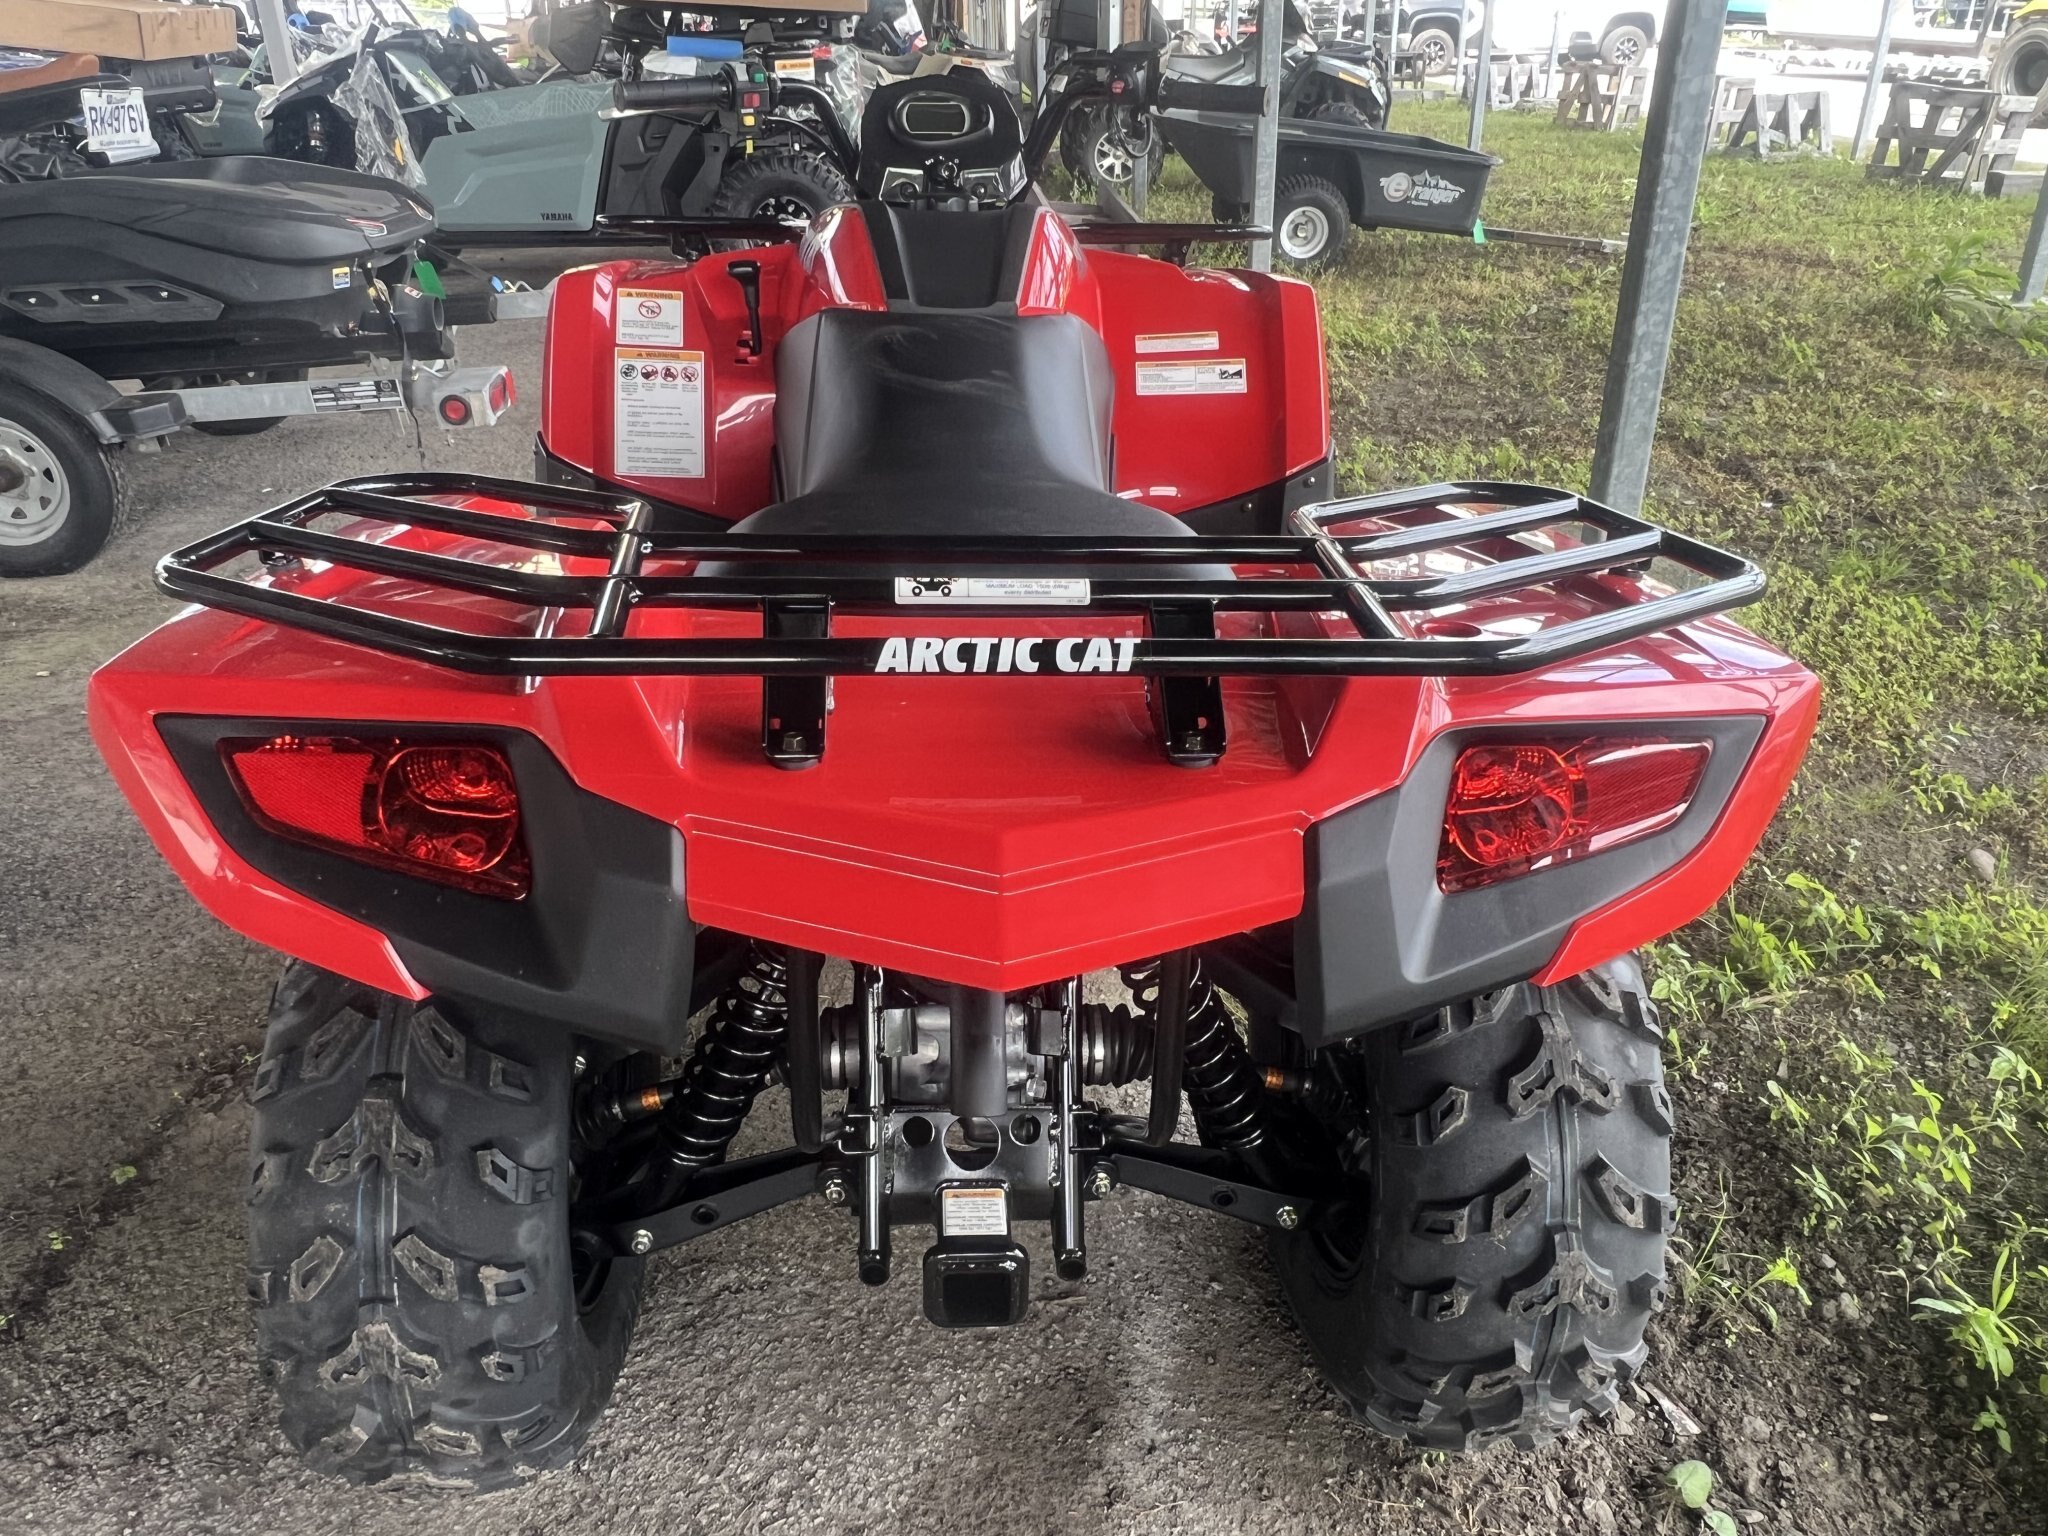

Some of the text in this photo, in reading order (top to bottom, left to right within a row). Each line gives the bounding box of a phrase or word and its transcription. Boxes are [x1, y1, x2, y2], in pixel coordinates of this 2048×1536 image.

[88, 104, 145, 136] RK4976V
[540, 212, 573, 221] YAMAHA
[874, 637, 1142, 673] ARCTIC CAT
